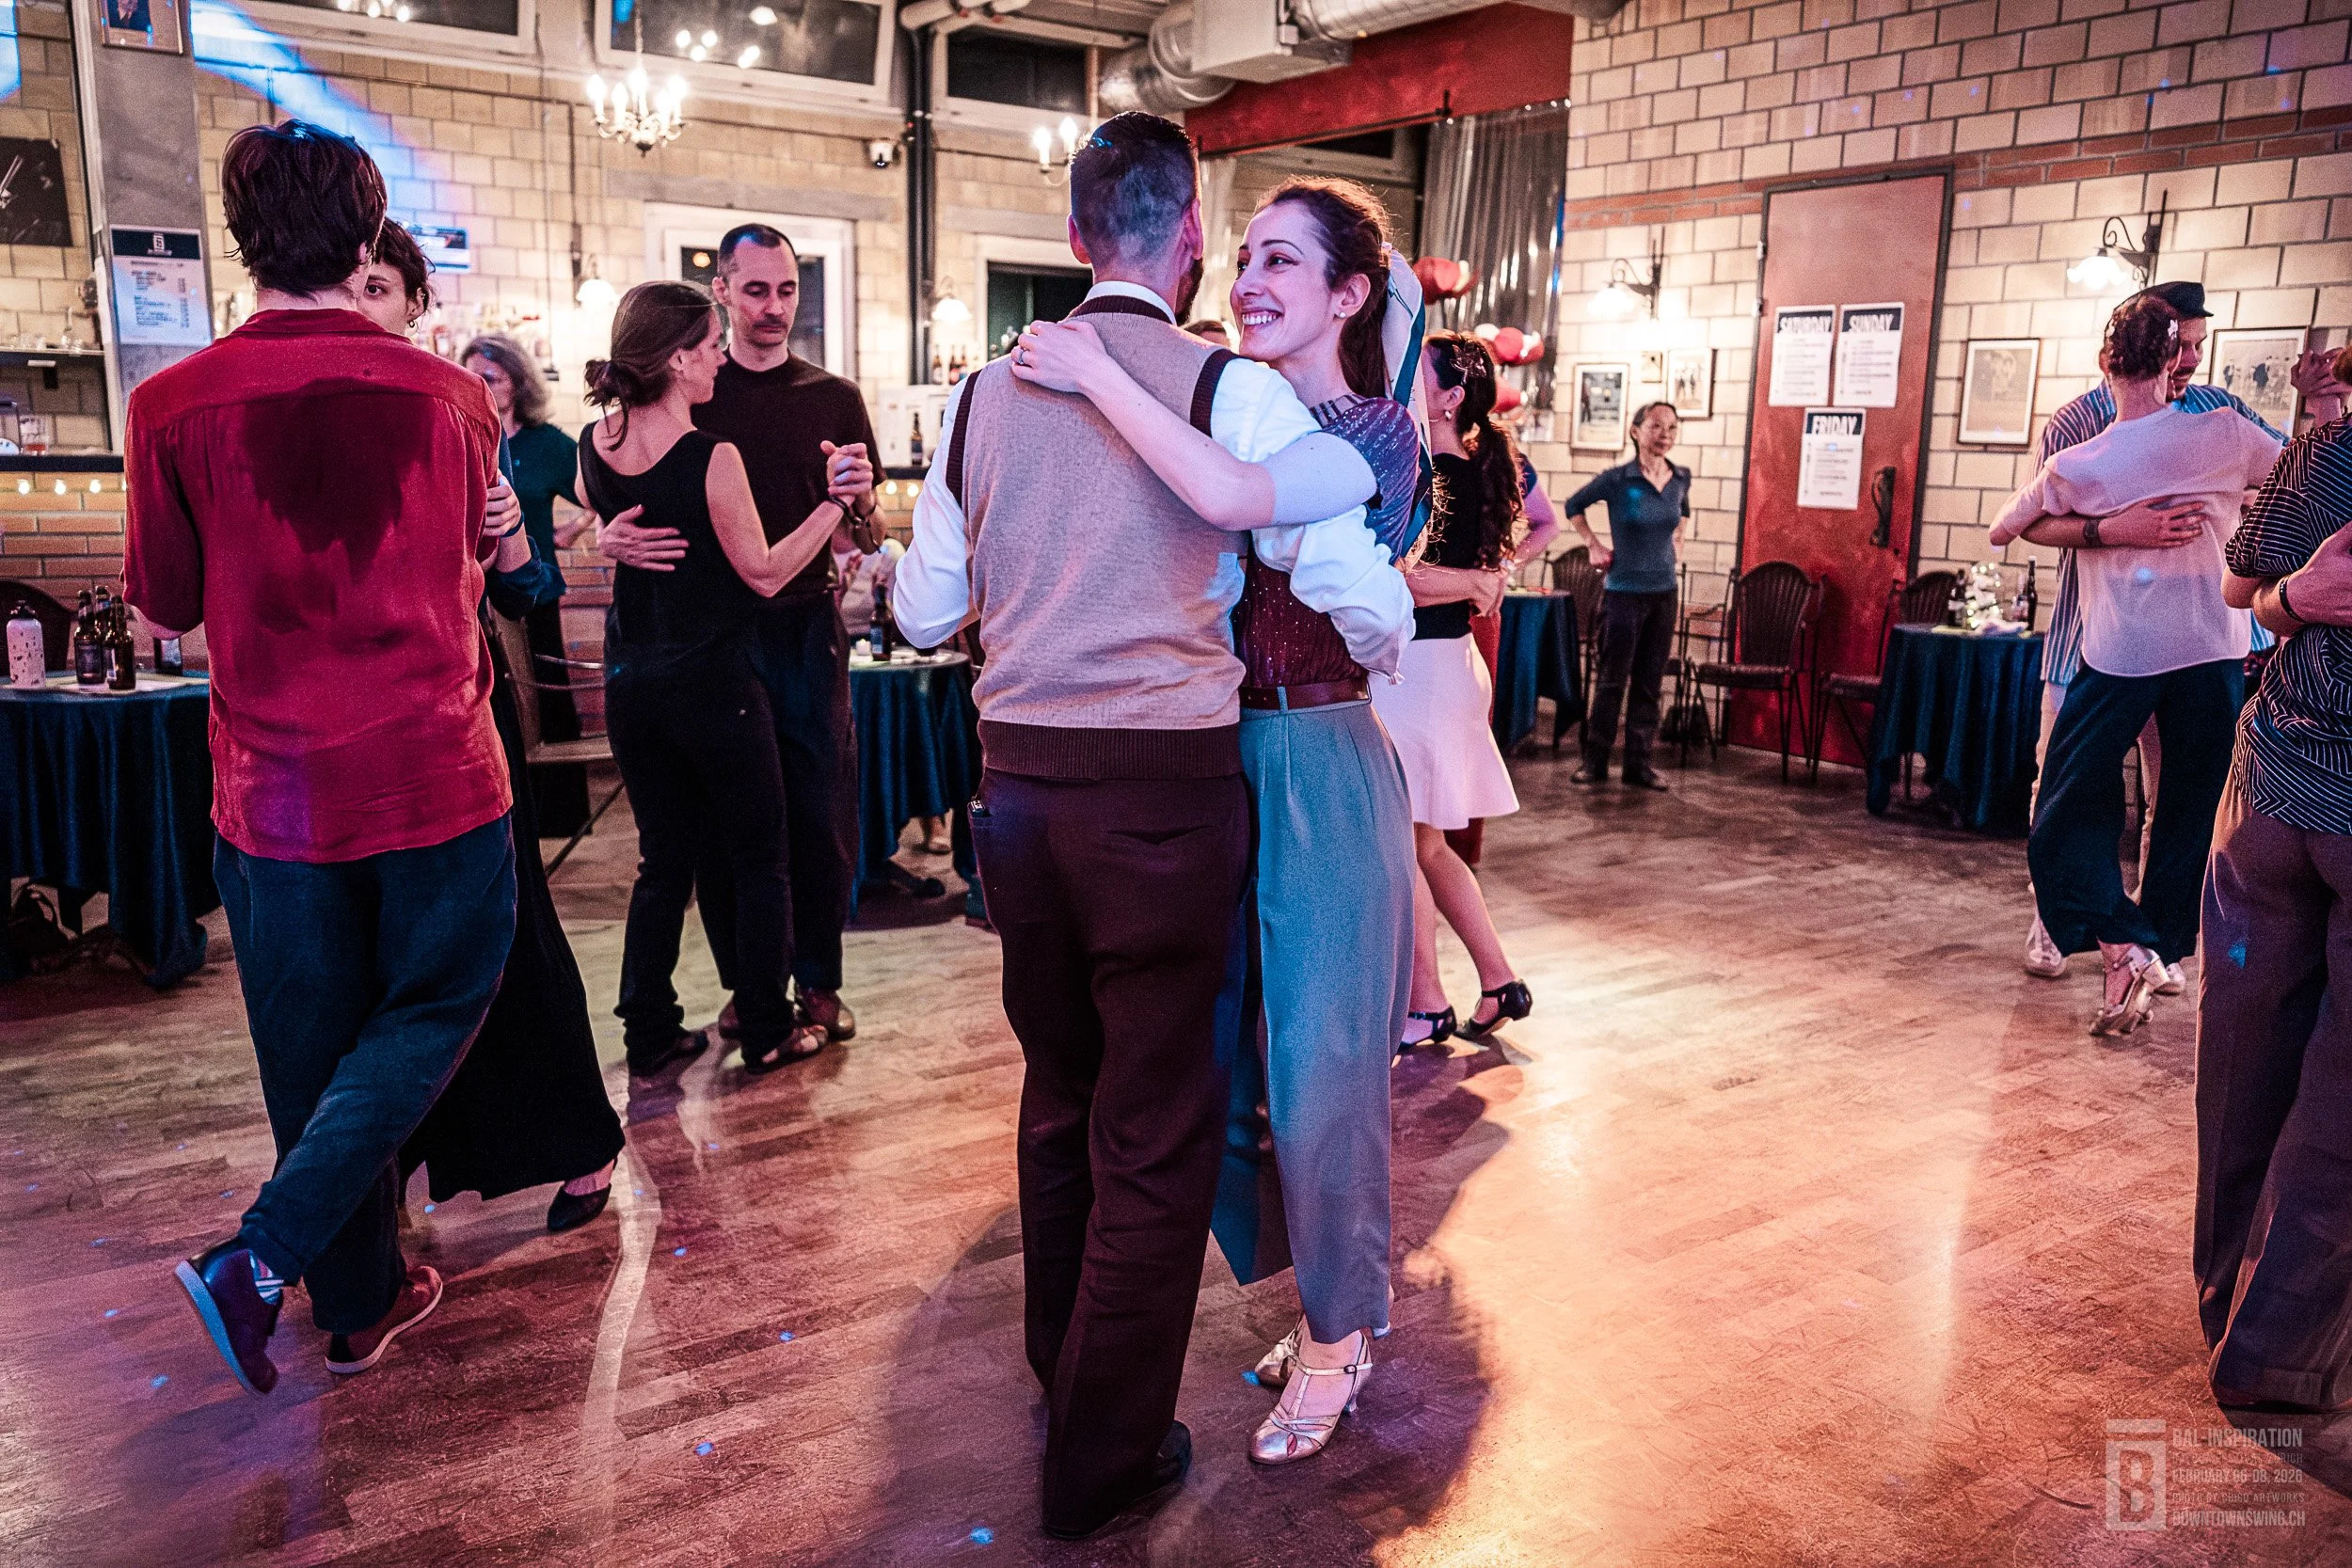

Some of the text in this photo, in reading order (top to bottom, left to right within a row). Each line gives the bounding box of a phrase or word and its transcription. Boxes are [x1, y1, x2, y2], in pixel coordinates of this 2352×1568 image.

[1779, 316, 1831, 332] SATURDAY
[1849, 313, 1894, 331] SUNDAY
[1812, 416, 1857, 436] FRIDAY
